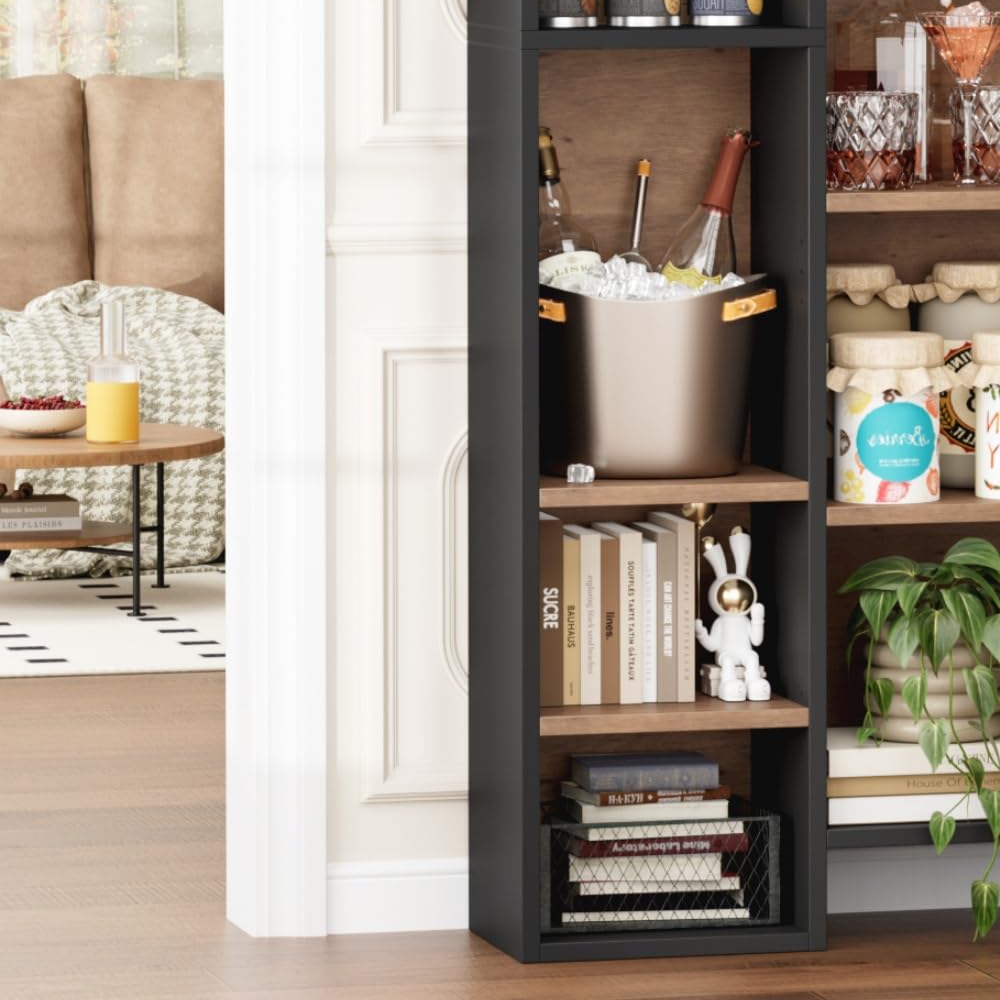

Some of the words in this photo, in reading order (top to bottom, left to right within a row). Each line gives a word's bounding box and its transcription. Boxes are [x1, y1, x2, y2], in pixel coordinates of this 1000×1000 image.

[543, 587, 559, 629] SUCRE
[567, 605, 576, 648] BAUHAUS
[907, 777, 943, 790] House
